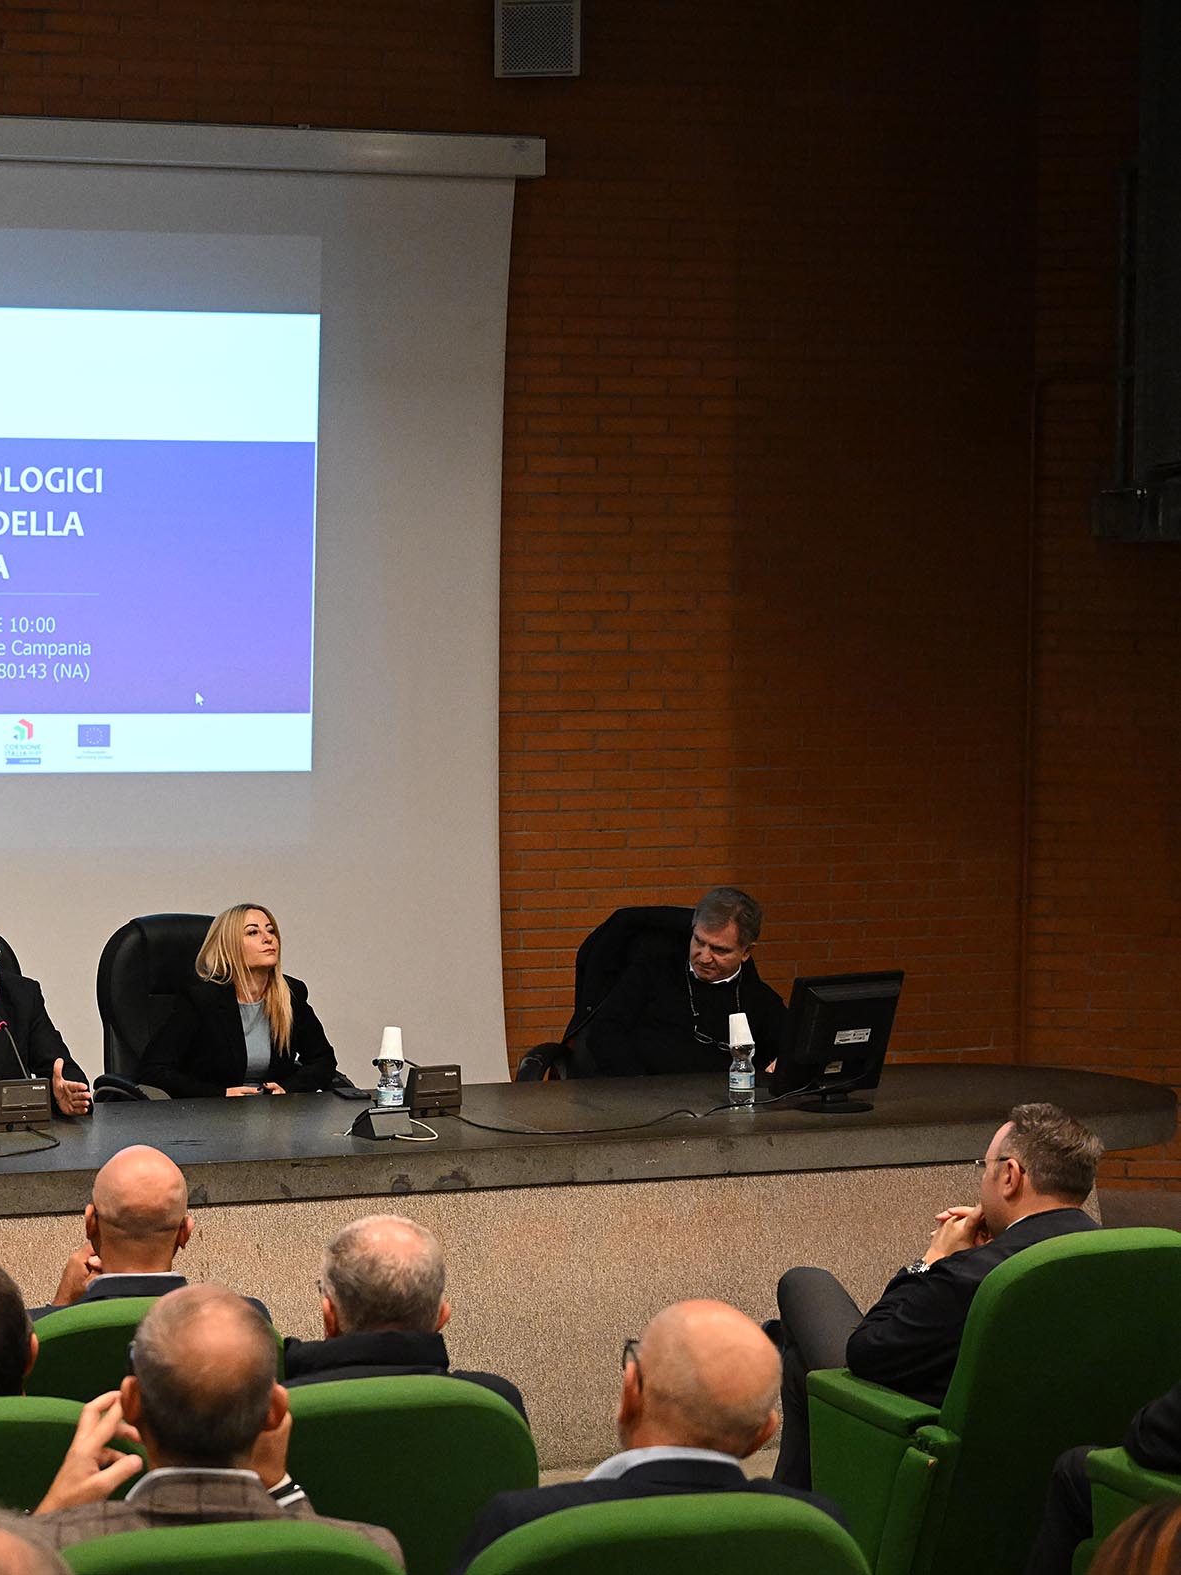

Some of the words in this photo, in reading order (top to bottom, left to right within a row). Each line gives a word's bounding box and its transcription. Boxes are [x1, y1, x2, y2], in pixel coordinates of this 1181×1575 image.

[10, 616, 56, 634] 10:00
[11, 640, 92, 660] Campania
[53, 663, 91, 682] (NA)
